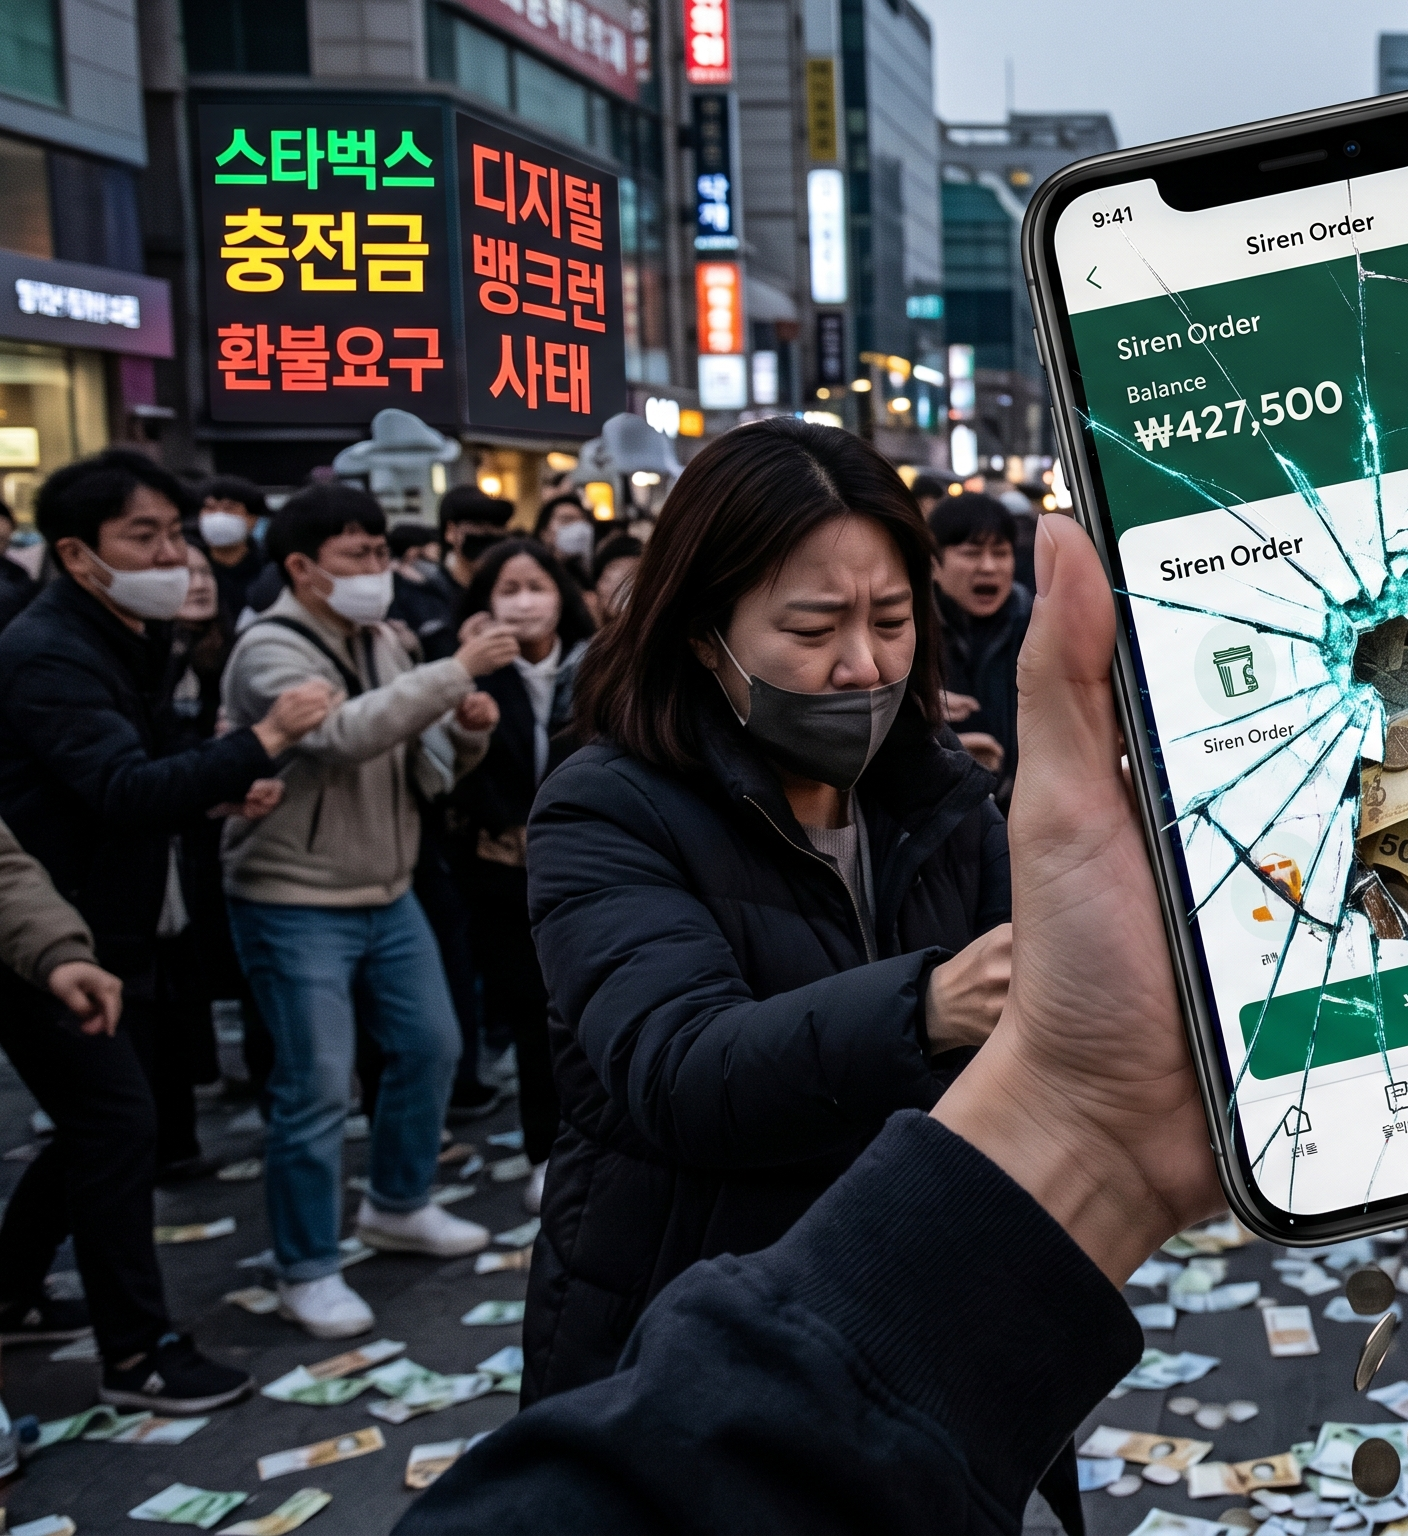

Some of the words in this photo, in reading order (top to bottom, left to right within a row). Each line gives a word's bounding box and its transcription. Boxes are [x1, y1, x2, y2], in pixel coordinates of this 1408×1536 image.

[214, 127, 435, 191] 스타벅스
[472, 143, 604, 252] 디지털
[1091, 205, 1135, 230] 9:41
[220, 207, 431, 293] 충전금
[1245, 228, 1305, 256] Siren
[1308, 213, 1376, 243] Order
[473, 233, 606, 334] 뱅크런
[217, 322, 444, 393] 환불요구
[1116, 330, 1183, 362] Siren
[1186, 312, 1262, 346] Order
[490, 334, 591, 415] 사태
[1126, 371, 1208, 405] Balance
[1133, 379, 1344, 453] ₩427,500
[1159, 549, 1227, 583] Siren
[1231, 534, 1304, 567] Order
[1203, 732, 1245, 756] Siren
[1247, 721, 1295, 745] Order
